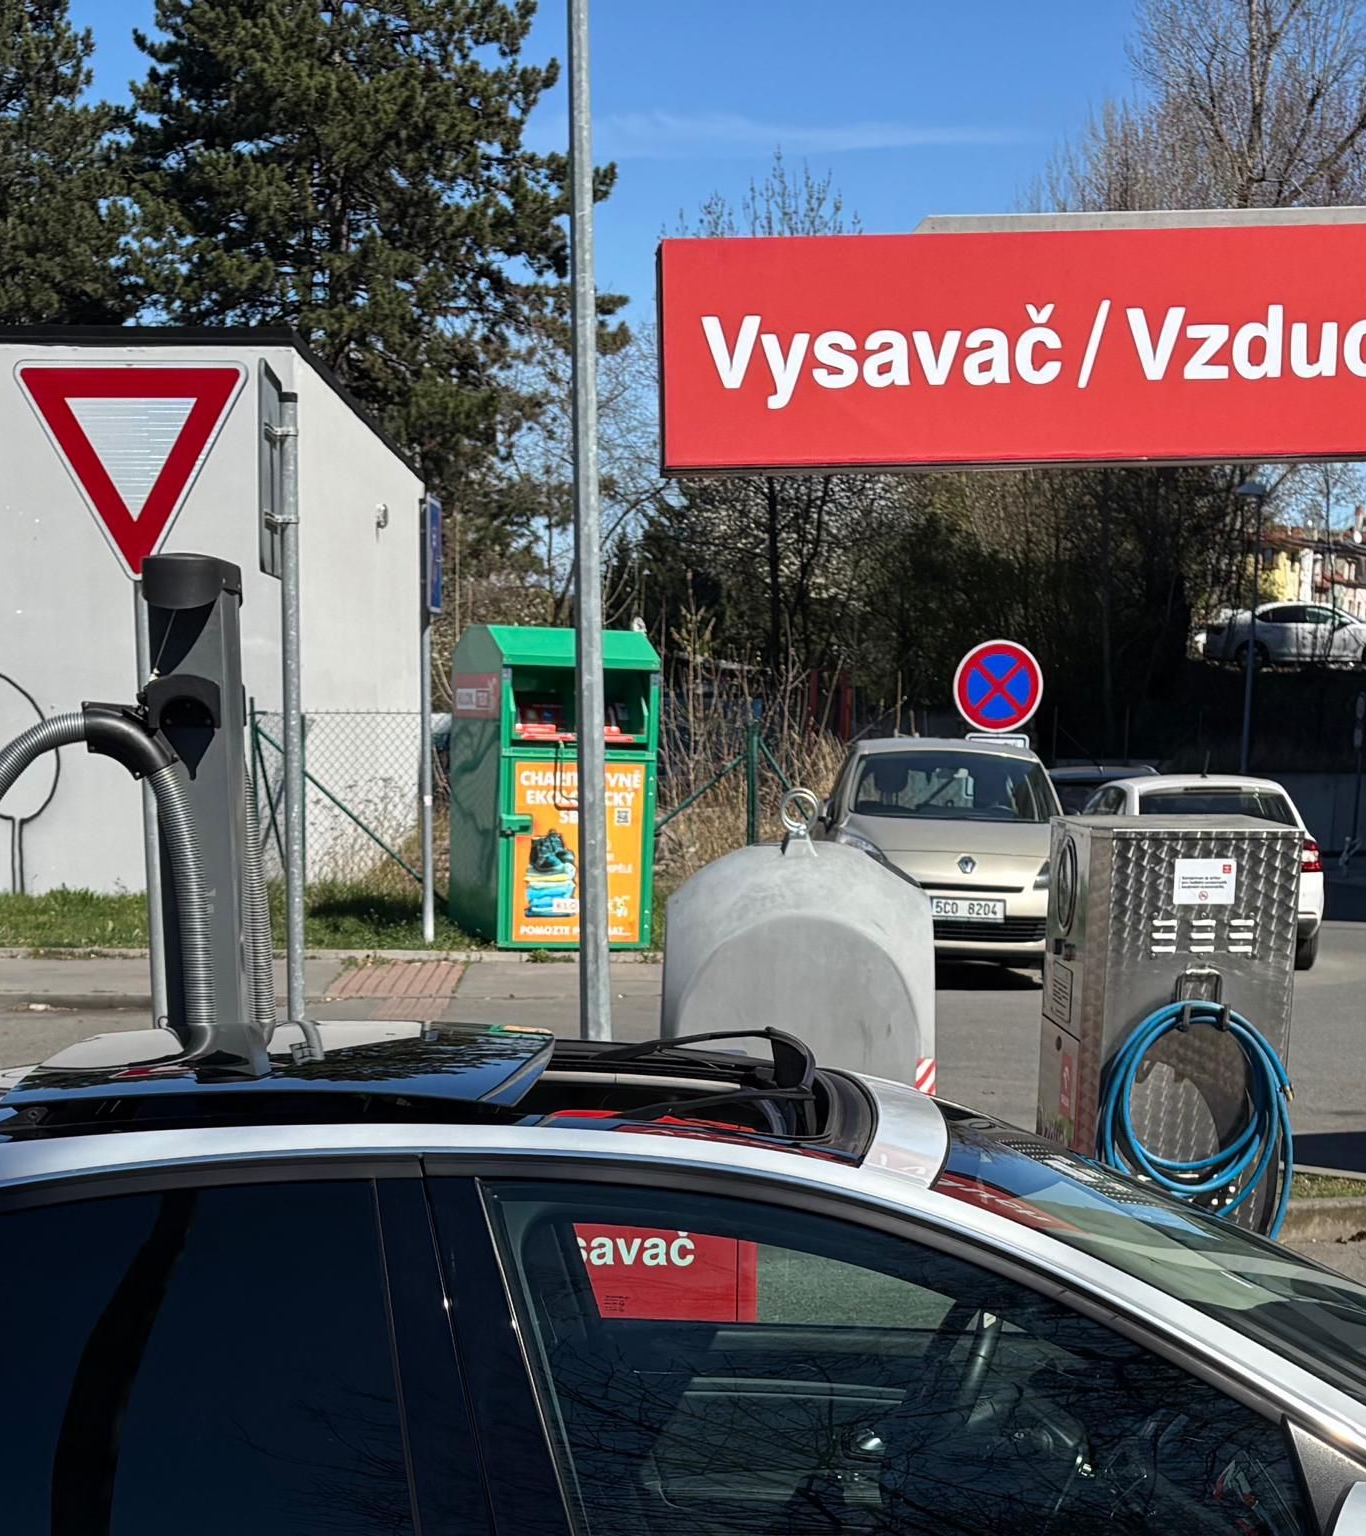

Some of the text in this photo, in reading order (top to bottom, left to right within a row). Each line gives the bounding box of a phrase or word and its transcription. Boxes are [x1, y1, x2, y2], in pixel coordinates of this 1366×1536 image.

[701, 303, 1062, 410] Vysavač
[1077, 299, 1111, 389] /
[968, 902, 998, 916] 8204
